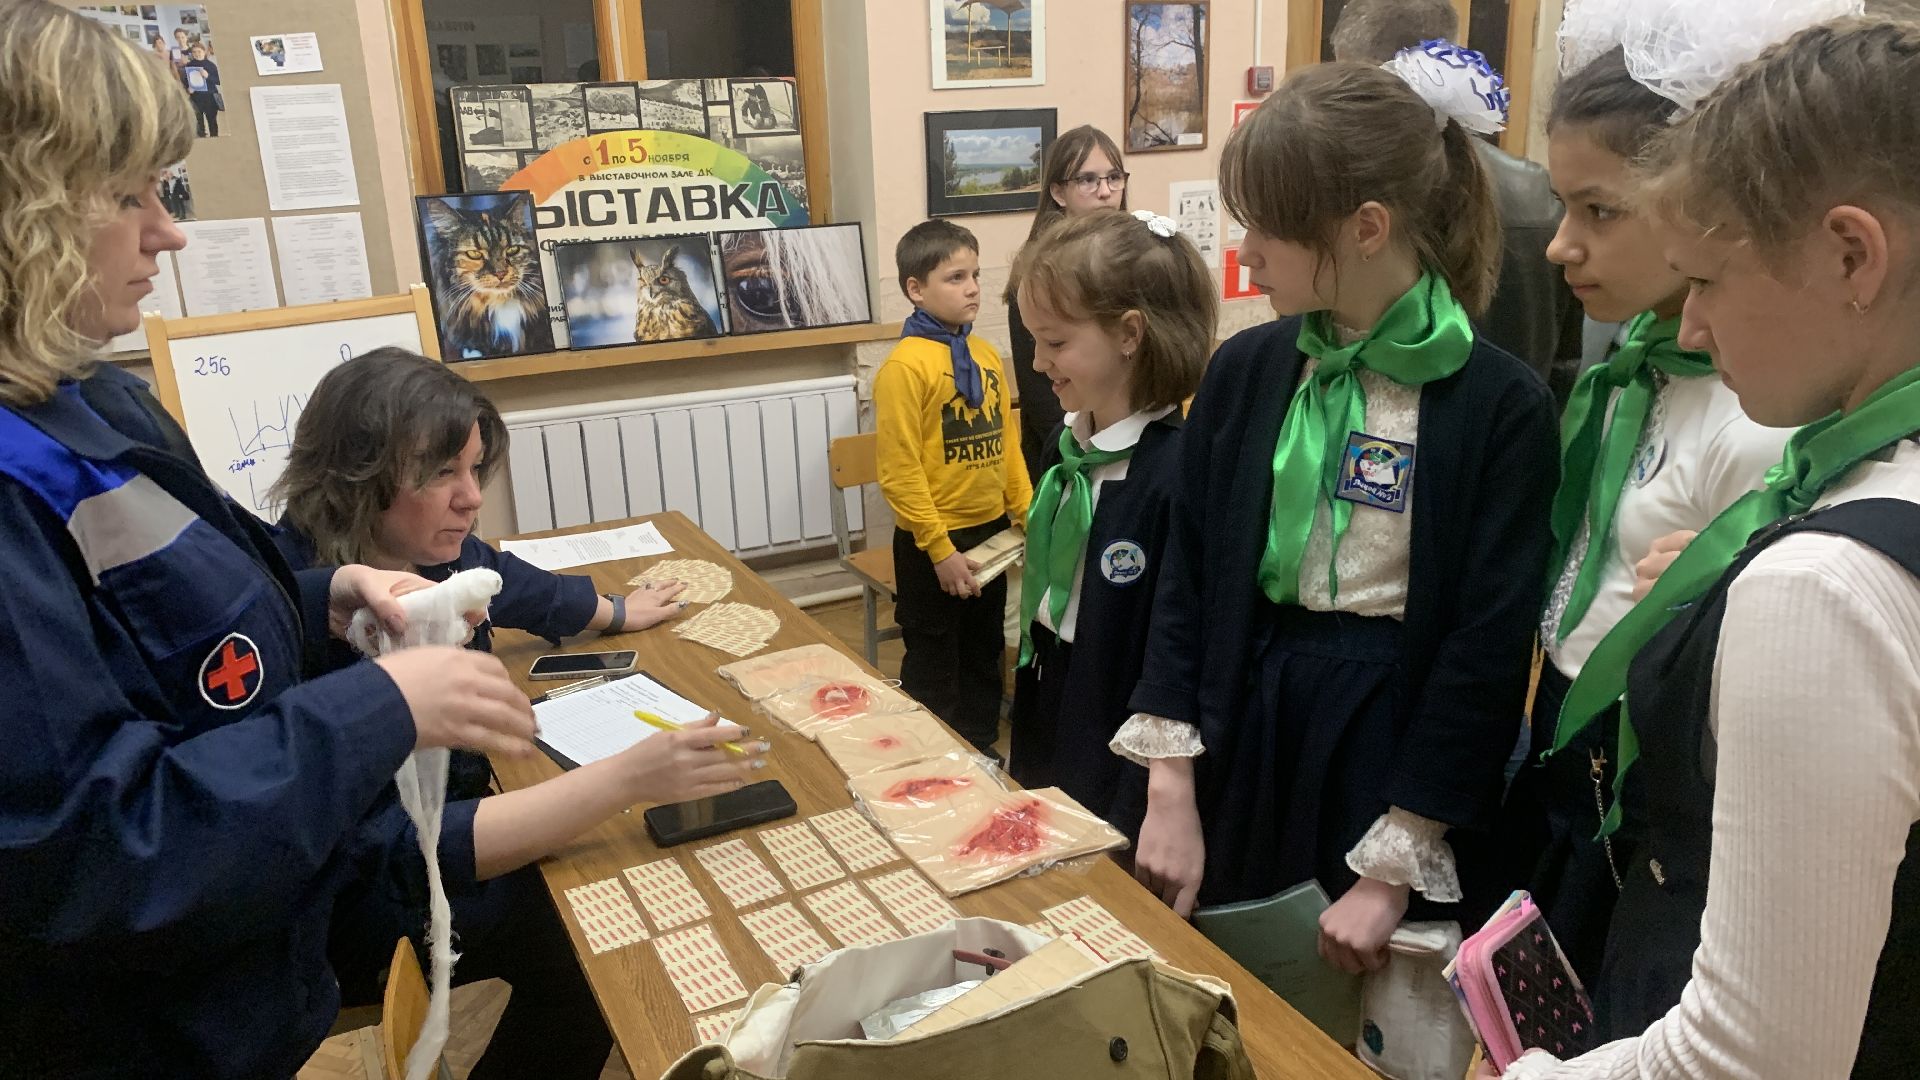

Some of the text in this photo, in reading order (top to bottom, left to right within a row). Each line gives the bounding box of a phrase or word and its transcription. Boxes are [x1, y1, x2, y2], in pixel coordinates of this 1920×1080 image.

[596, 139, 610, 165] 1
[628, 138, 648, 164] 5
[589, 171, 668, 181] ВЫСТАВОЧНОМ
[671, 170, 694, 178] ЗАЛЕ
[697, 168, 713, 177] ДК
[532, 182, 787, 229] ЫСТАВКА
[194, 356, 231, 376] 256
